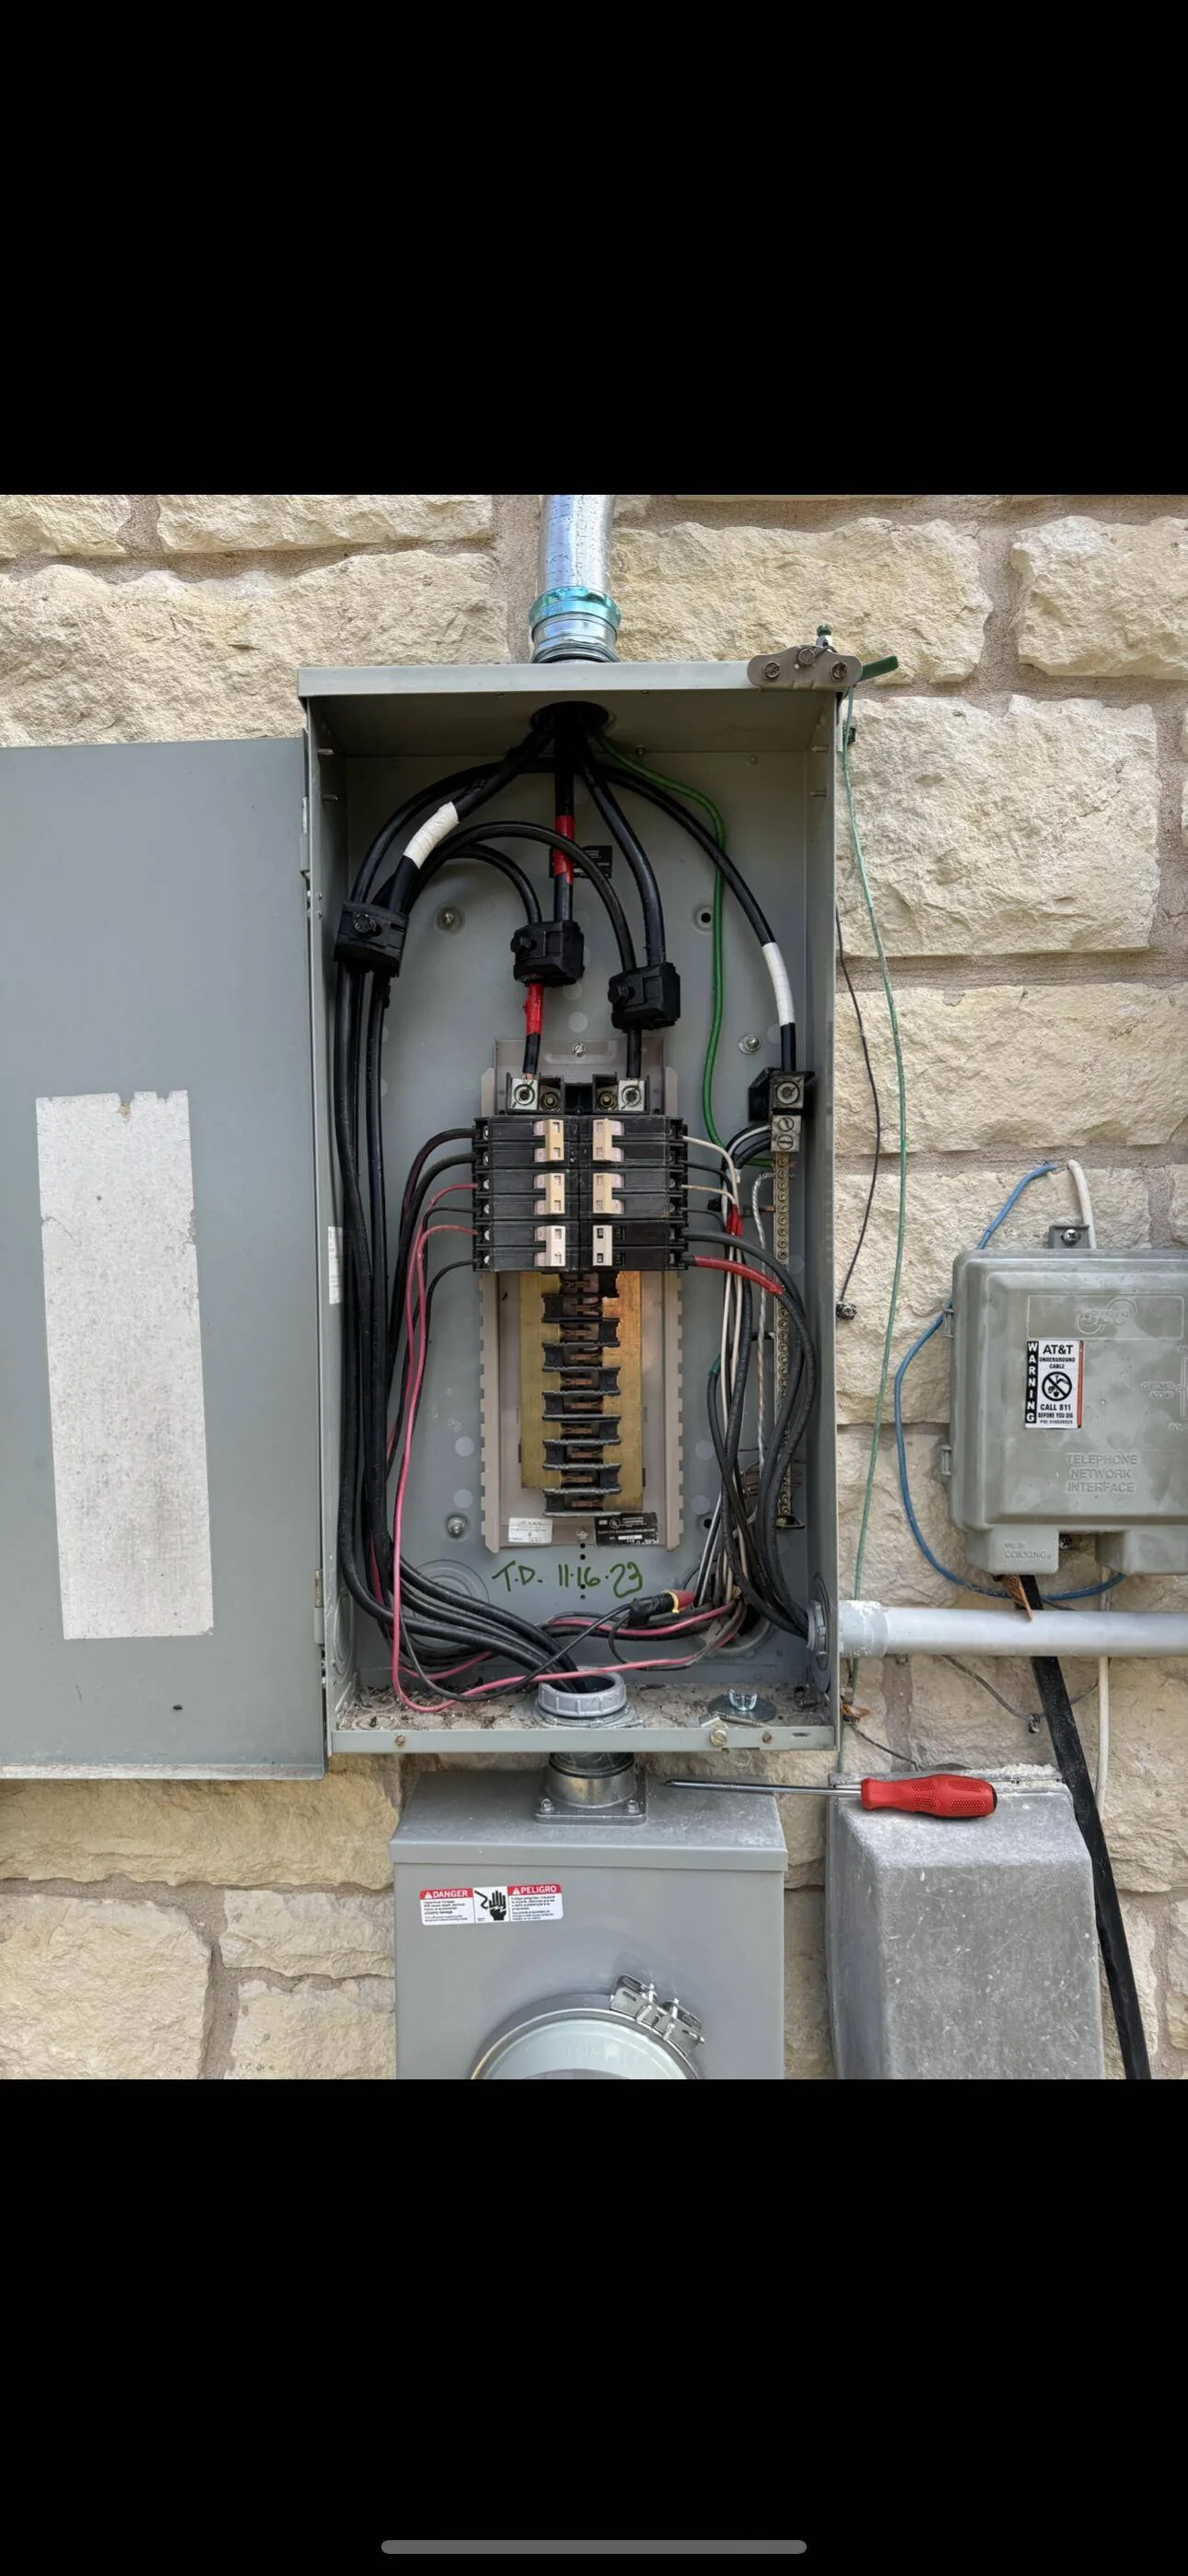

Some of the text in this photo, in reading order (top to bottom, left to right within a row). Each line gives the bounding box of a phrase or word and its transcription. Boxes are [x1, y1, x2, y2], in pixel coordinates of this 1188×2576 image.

[1042, 1344, 1074, 1354] AT&T
[1026, 1342, 1039, 1422] WARNING
[1040, 1403, 1072, 1411] CALL 811
[1066, 1454, 1138, 1466] TELEPHONE
[1070, 1469, 1132, 1480] NETWORK
[1067, 1481, 1135, 1493] INTERFACE
[433, 1886, 557, 1899] DANGER PELIGRO
